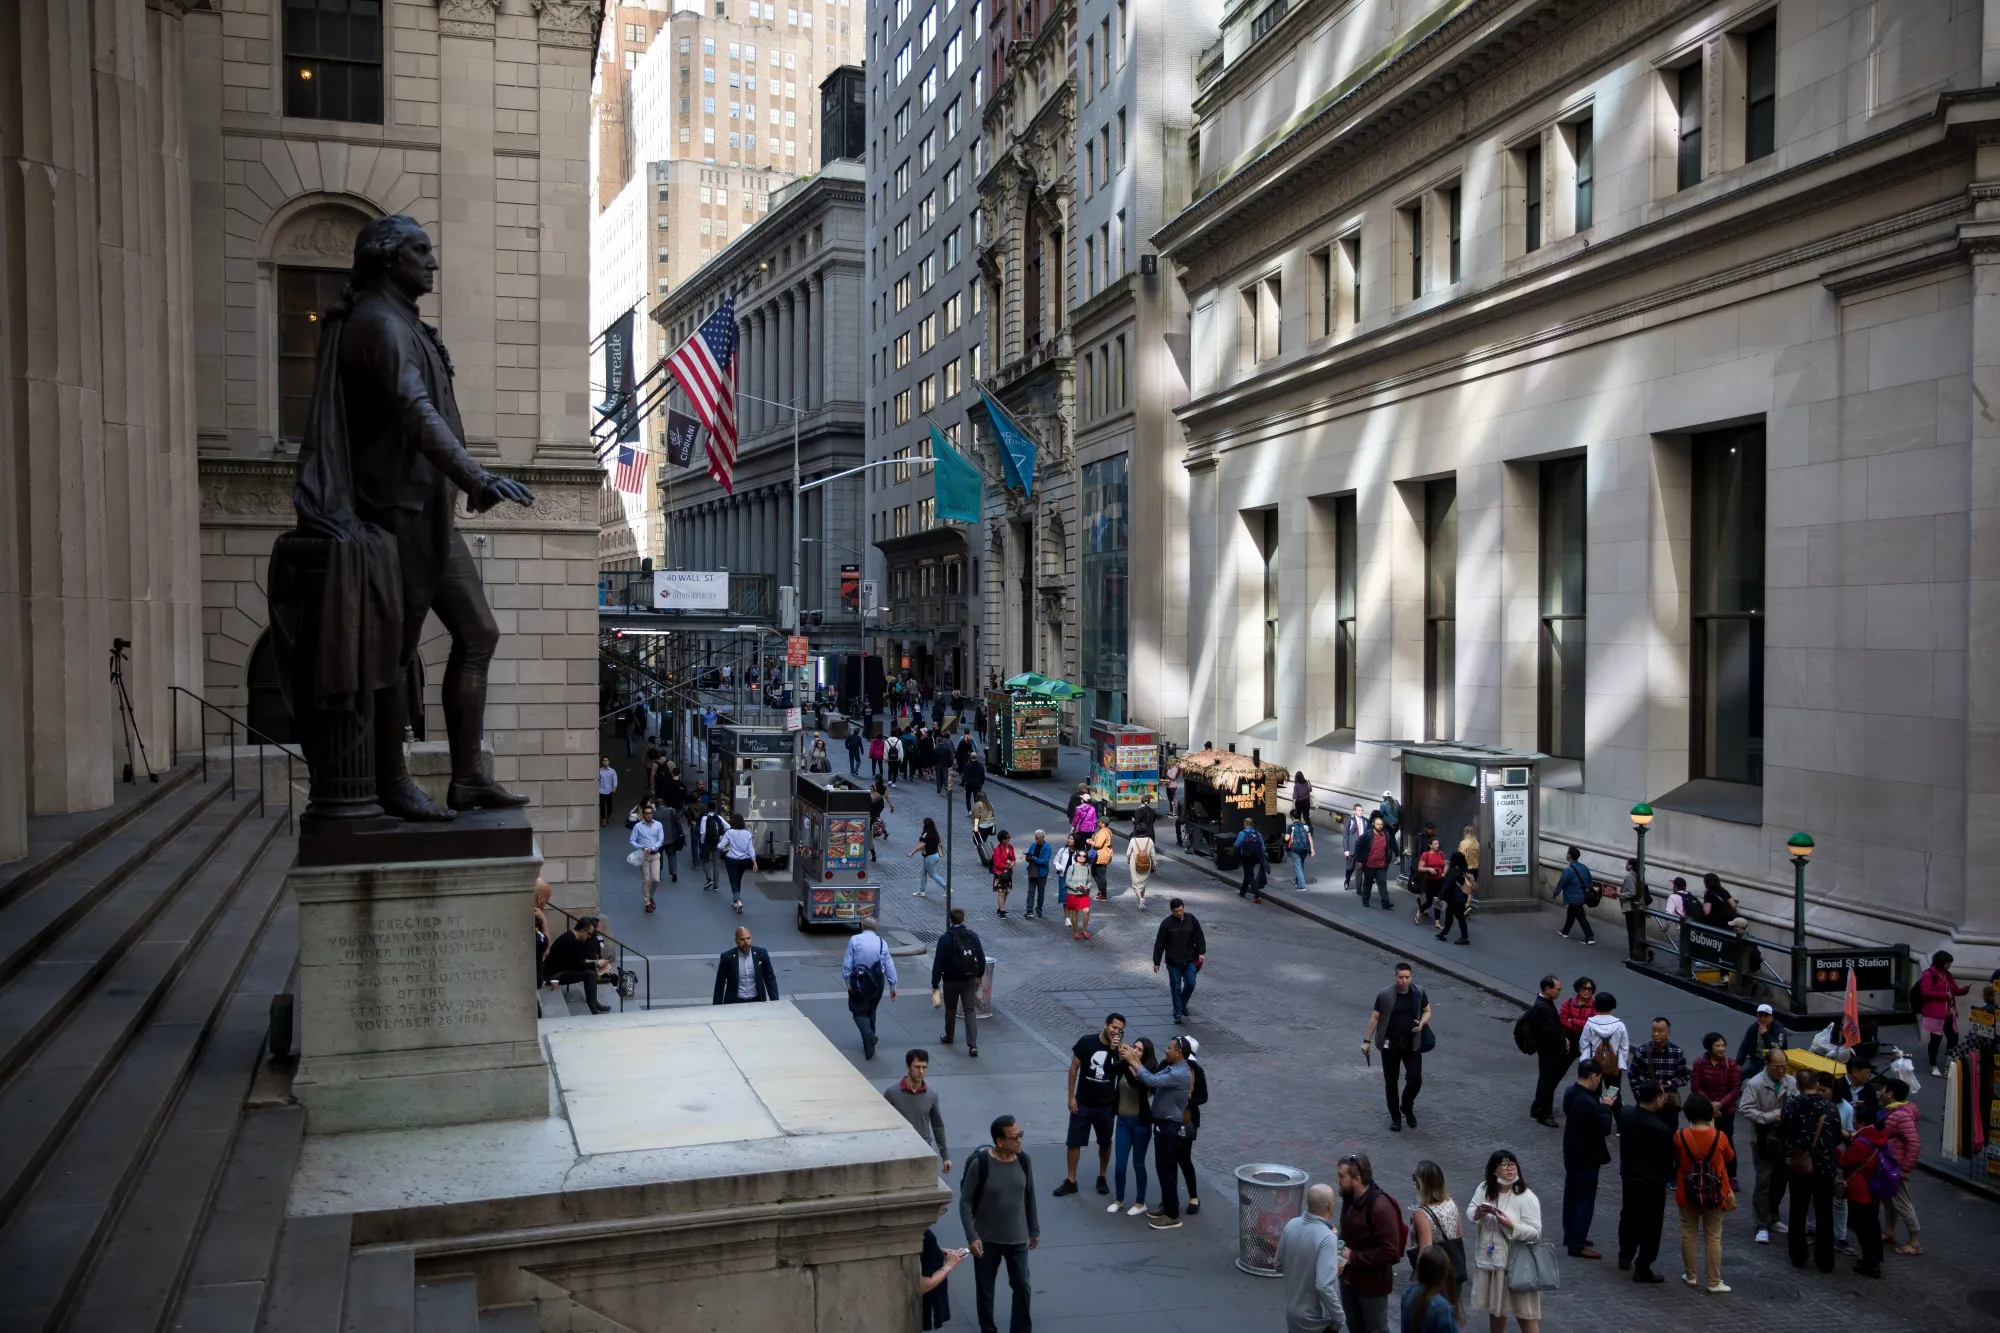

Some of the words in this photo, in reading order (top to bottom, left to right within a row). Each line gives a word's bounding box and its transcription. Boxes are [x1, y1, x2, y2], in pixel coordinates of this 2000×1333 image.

[680, 424, 696, 461] CIPRIANI
[666, 574, 677, 582] 40
[678, 574, 700, 582] WALL
[704, 574, 716, 582] ST.
[1225, 795, 1255, 803] JAMROCK
[1237, 801, 1254, 809] JERK
[378, 916, 441, 929] ERECTED
[329, 933, 407, 947] VOLUNTARY
[414, 928, 510, 943] SUBSCRIPTION
[1690, 930, 1723, 952] Subway
[344, 948, 391, 960] UNDER
[399, 945, 424, 957] THE
[1816, 959, 1842, 969] Broad
[1845, 958, 1855, 968] St
[1858, 958, 1889, 968] Station
[406, 974, 423, 986] OF
[398, 989, 413, 1000] OF
[420, 987, 445, 999] THE
[349, 1005, 393, 1018] STATE
[420, 1001, 452, 1014] NEW
[355, 1016, 432, 1031] NOVEMBER
[438, 1015, 453, 1028] 26
